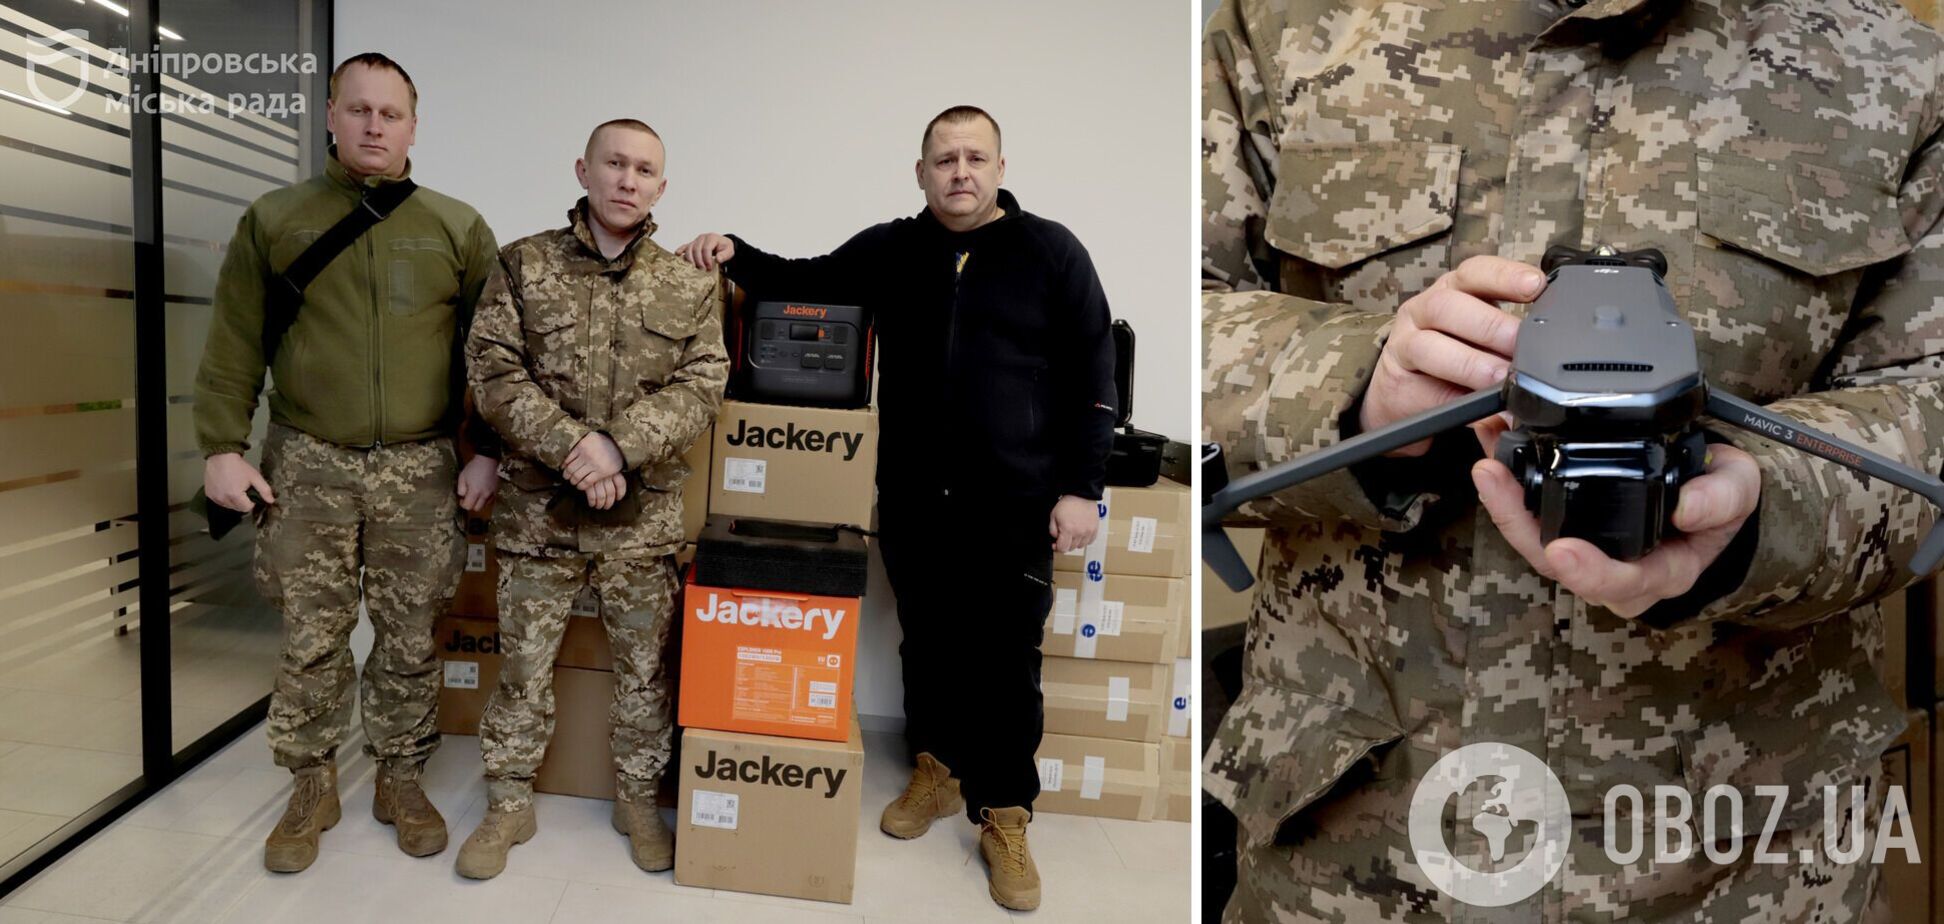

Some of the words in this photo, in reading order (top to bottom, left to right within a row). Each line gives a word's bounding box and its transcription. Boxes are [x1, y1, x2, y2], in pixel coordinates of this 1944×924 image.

[783, 304, 827, 318] Jackery
[726, 419, 864, 461] Jackery
[1744, 414, 1782, 436] MAVIC
[1784, 429, 1795, 440] 3
[1796, 433, 1863, 466] ENTERPRISE
[695, 592, 846, 640] Jackery
[695, 750, 847, 798] Jackery
